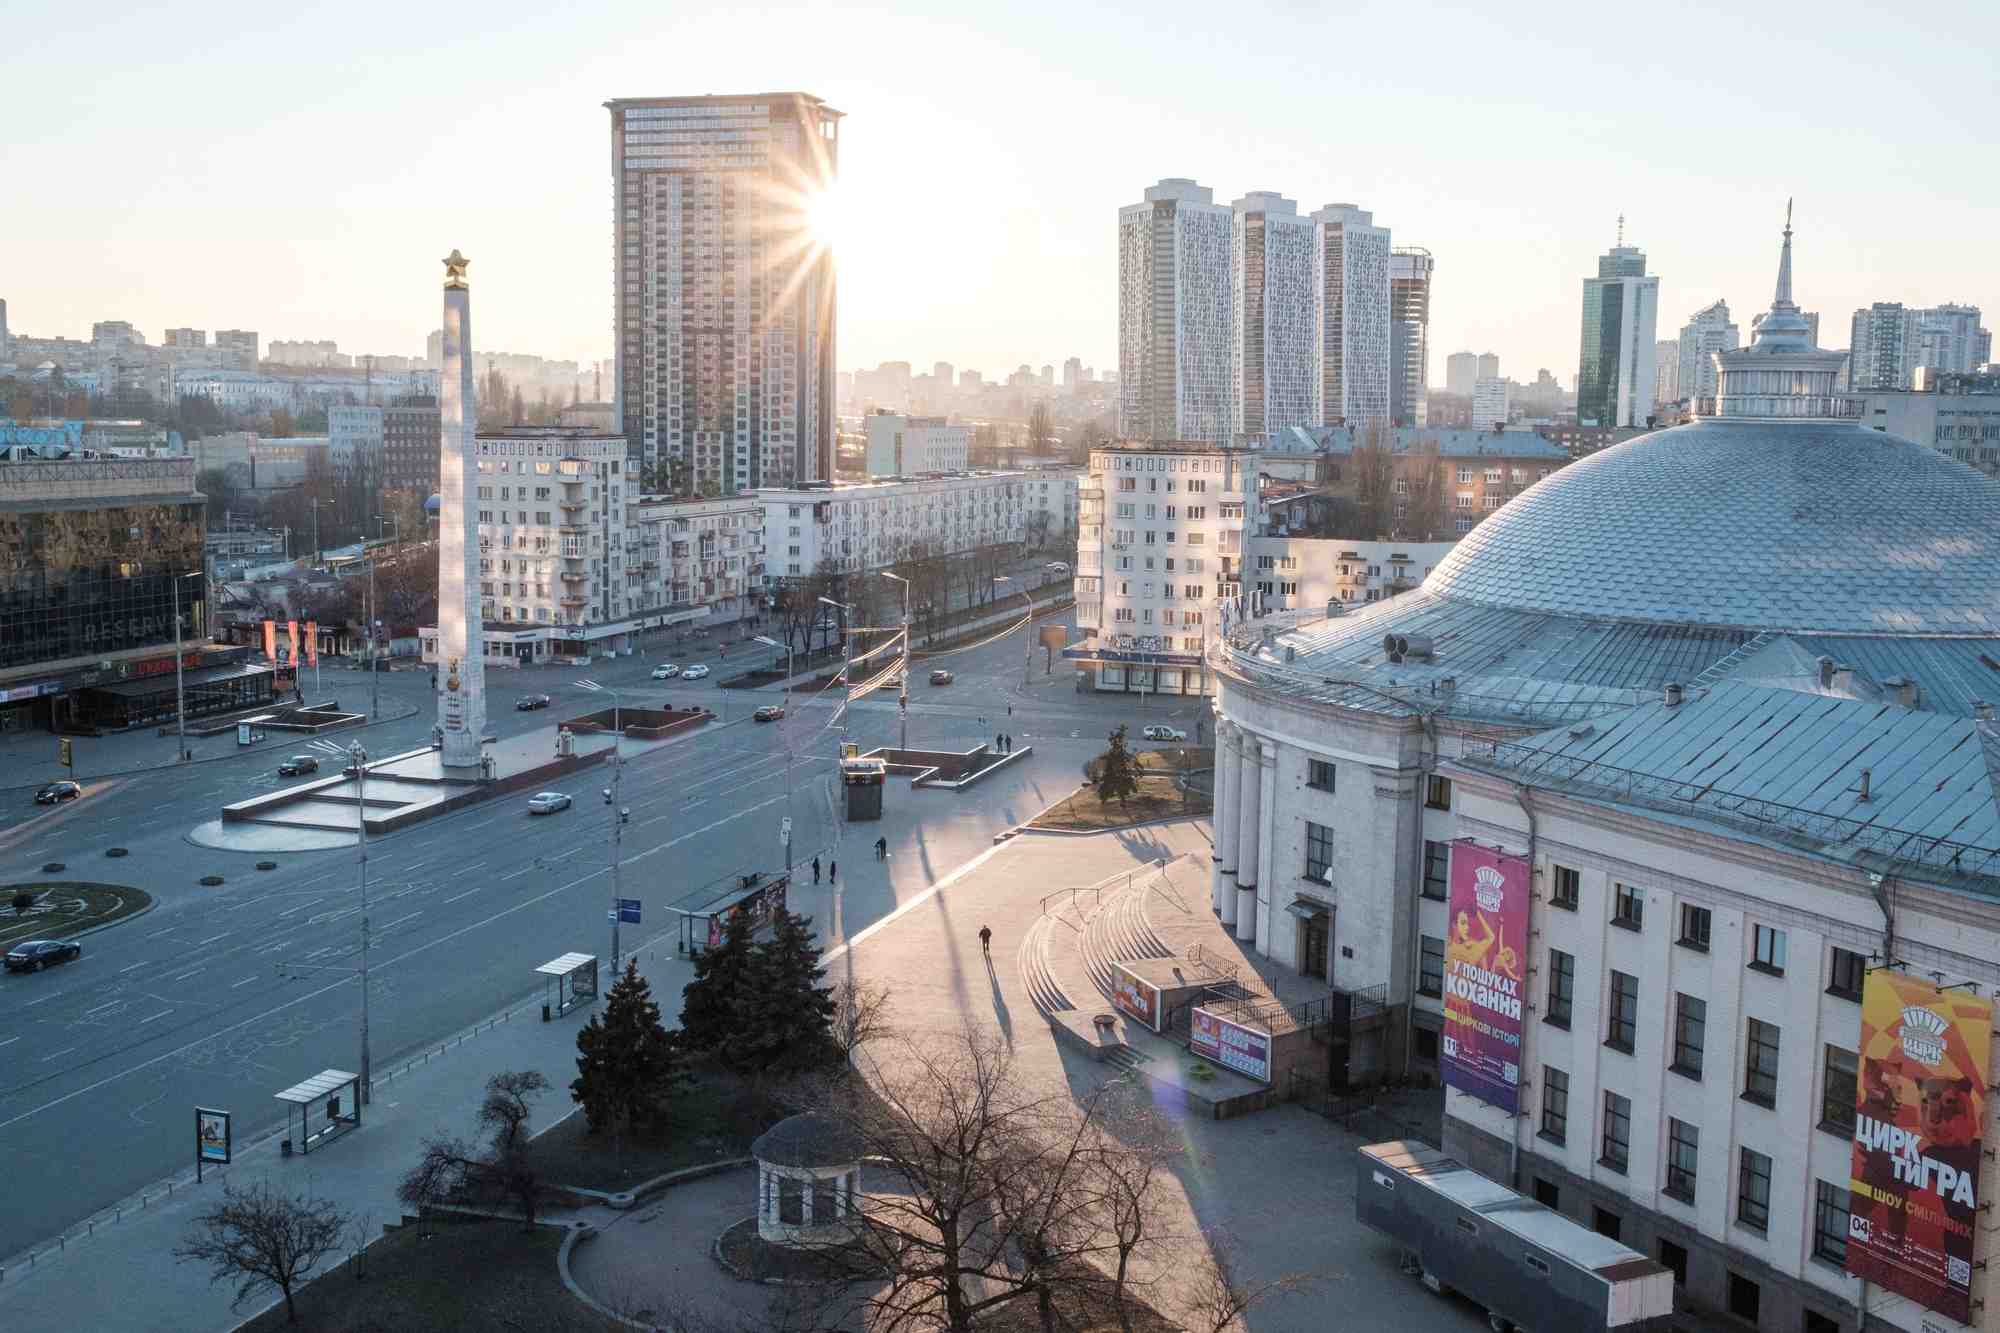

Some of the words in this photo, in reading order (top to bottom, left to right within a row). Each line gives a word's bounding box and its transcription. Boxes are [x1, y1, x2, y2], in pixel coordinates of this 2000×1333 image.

[1453, 959, 1462, 974] У
[1463, 962, 1518, 997] ПОШУКАХ
[1855, 1113, 1921, 1165] ЦИРК
[1873, 1187, 1904, 1209] ШОУ
[1890, 1154, 1975, 1209] ТИГРА
[1852, 1217, 1868, 1231] 04
